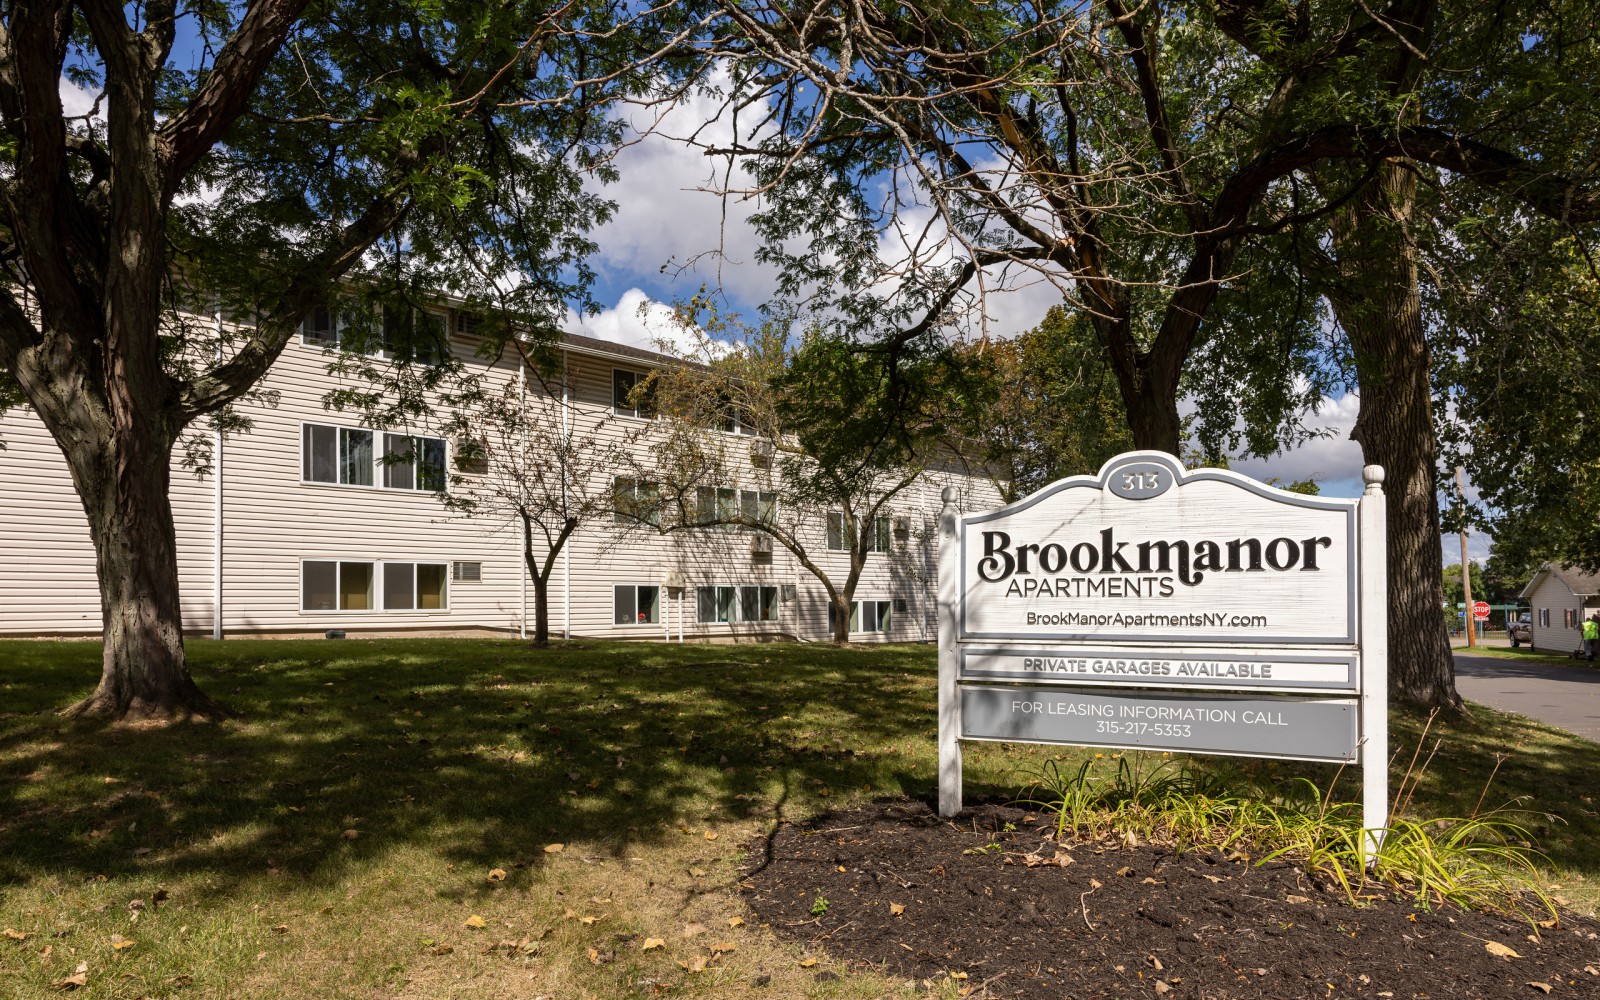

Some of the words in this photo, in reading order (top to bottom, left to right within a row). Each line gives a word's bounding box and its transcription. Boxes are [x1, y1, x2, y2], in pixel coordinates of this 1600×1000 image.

[1121, 471, 1159, 491] 313
[977, 526, 1332, 587] Brookmanor
[1005, 577, 1175, 598] APARTMENTS
[1026, 611, 1267, 628] BrookManorApartmentsNY.com
[1023, 658, 1087, 673] PRIVATE
[1092, 660, 1171, 675] GARAGES
[1176, 662, 1272, 678] AVAILABLE
[1012, 701, 1043, 714] FOR
[1048, 702, 1114, 717] LEASING
[1120, 705, 1236, 723] INFORMATION
[1242, 711, 1288, 726] CALL
[1096, 720, 1191, 738] 315-217-5353
